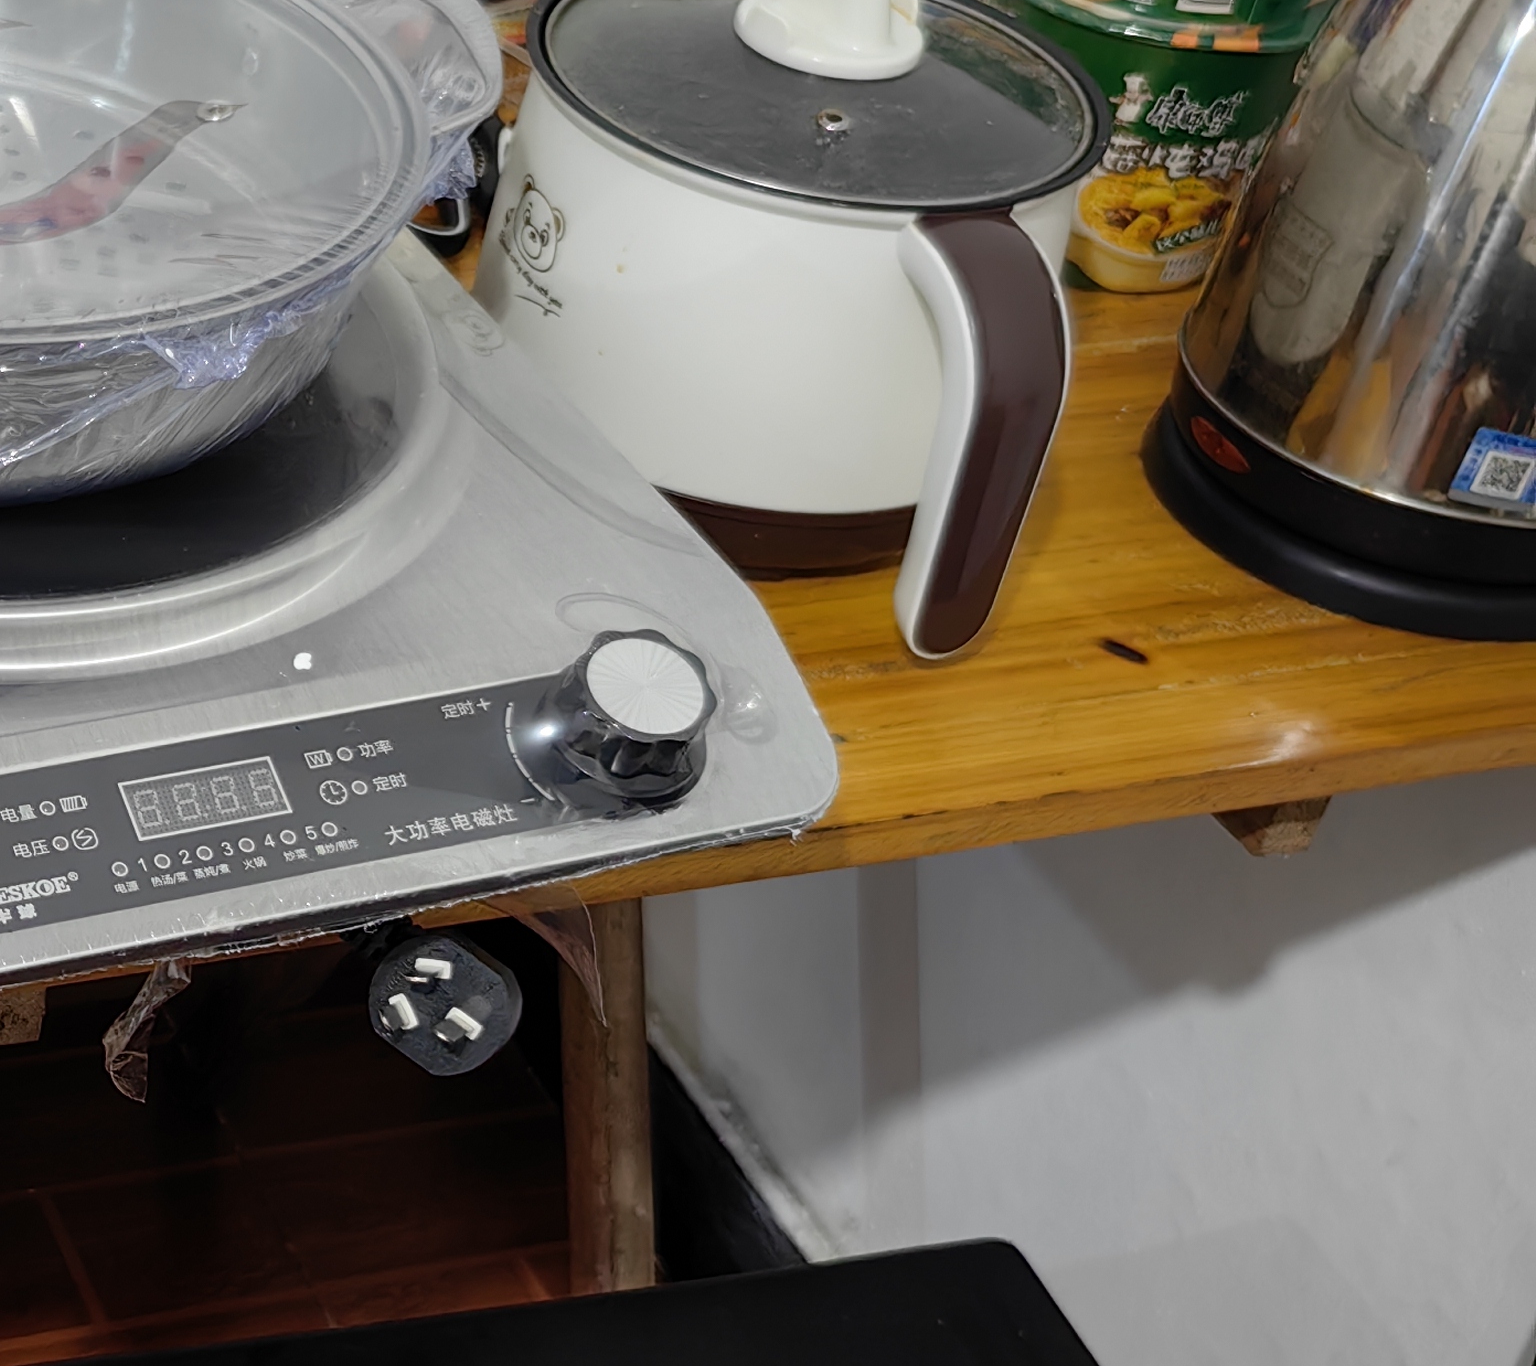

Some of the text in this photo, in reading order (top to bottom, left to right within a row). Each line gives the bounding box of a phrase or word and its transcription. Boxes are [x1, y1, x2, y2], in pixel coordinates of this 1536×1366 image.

[357, 739, 394, 758] 功率
[372, 772, 407, 792] 定时
[0, 804, 38, 823] 电量
[384, 803, 518, 846] 大功率电磁灶
[12, 838, 50, 858] 电压
[137, 825, 318, 873] 1 2 3 4 5
[114, 880, 141, 894] 电源
[242, 856, 267, 870] 火锅
[282, 847, 308, 863] 炒菜
